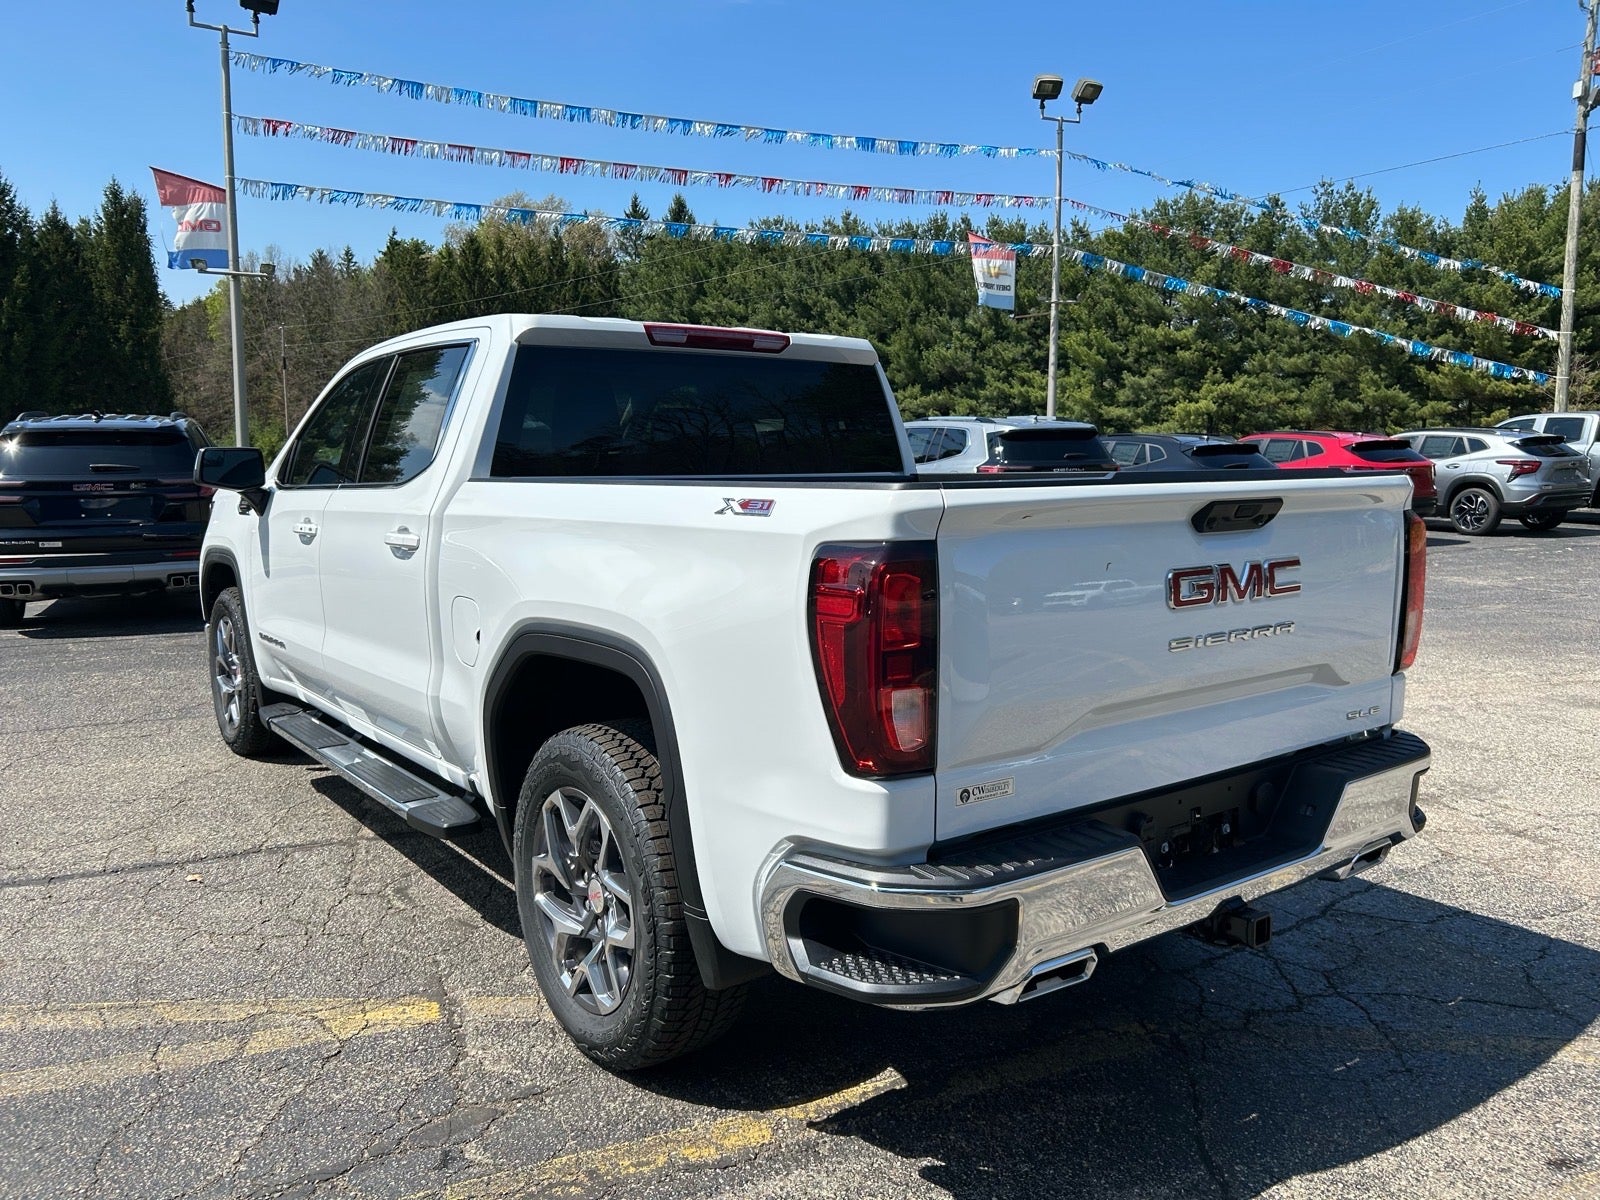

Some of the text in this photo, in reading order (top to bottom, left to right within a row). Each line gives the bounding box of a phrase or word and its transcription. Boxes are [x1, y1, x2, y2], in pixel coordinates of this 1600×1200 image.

[73, 483, 114, 492] GMC
[714, 497, 777, 518] X31
[1166, 553, 1302, 610] GMC
[1168, 619, 1296, 653] SIERRA
[1346, 705, 1382, 721] SLE
